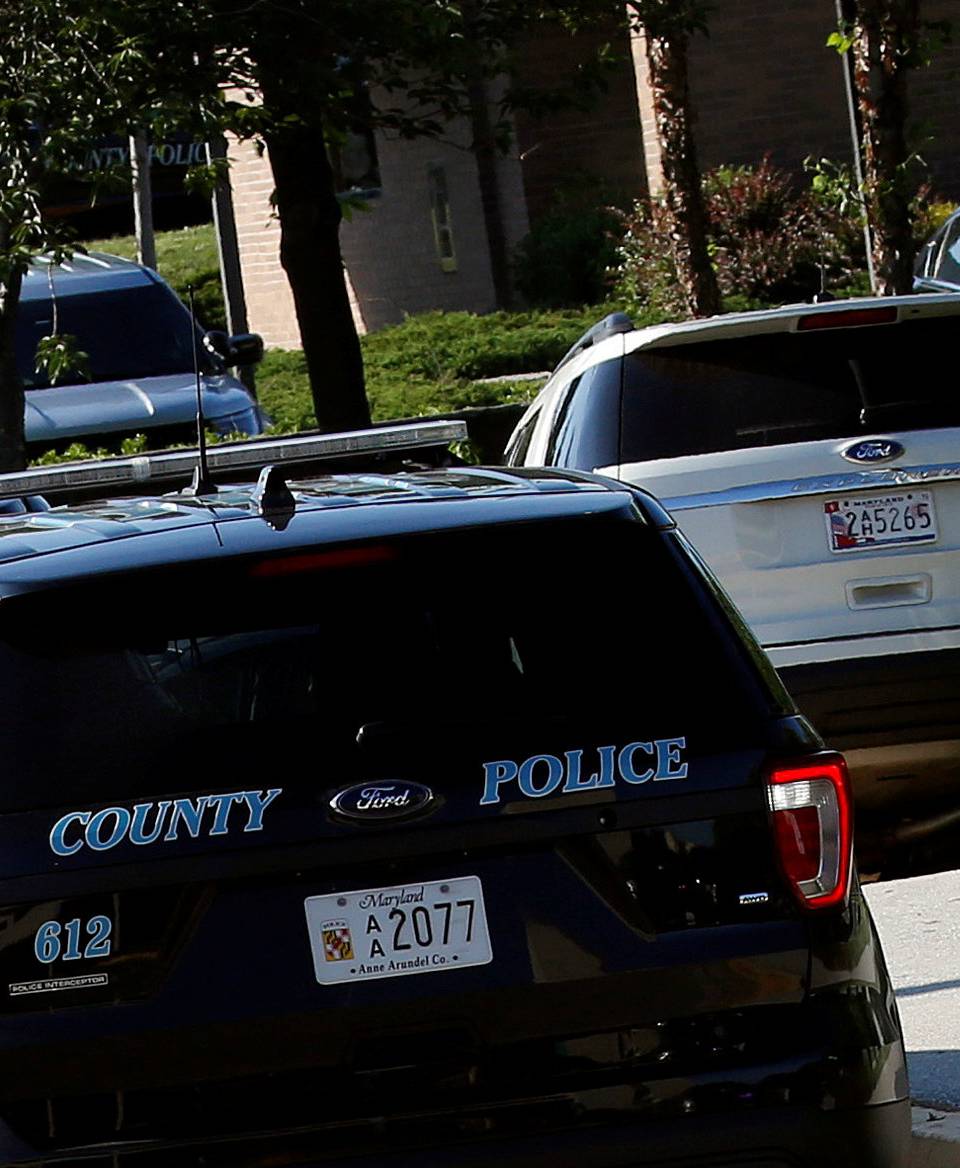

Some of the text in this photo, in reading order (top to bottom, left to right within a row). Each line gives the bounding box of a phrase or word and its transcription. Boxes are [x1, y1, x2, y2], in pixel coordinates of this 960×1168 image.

[147, 143, 207, 167] POLIC
[856, 443, 891, 459] Ford
[845, 503, 931, 537] 2AH5265
[479, 736, 689, 806] POLICE
[356, 786, 411, 810] Ford
[49, 788, 283, 857] COUNTY
[359, 886, 424, 911] Maryland
[34, 915, 112, 964] 612
[358, 963, 385, 975] Anne
[388, 955, 429, 971] Arundel
[12, 976, 105, 992] POLICE INTERCEPTOR
